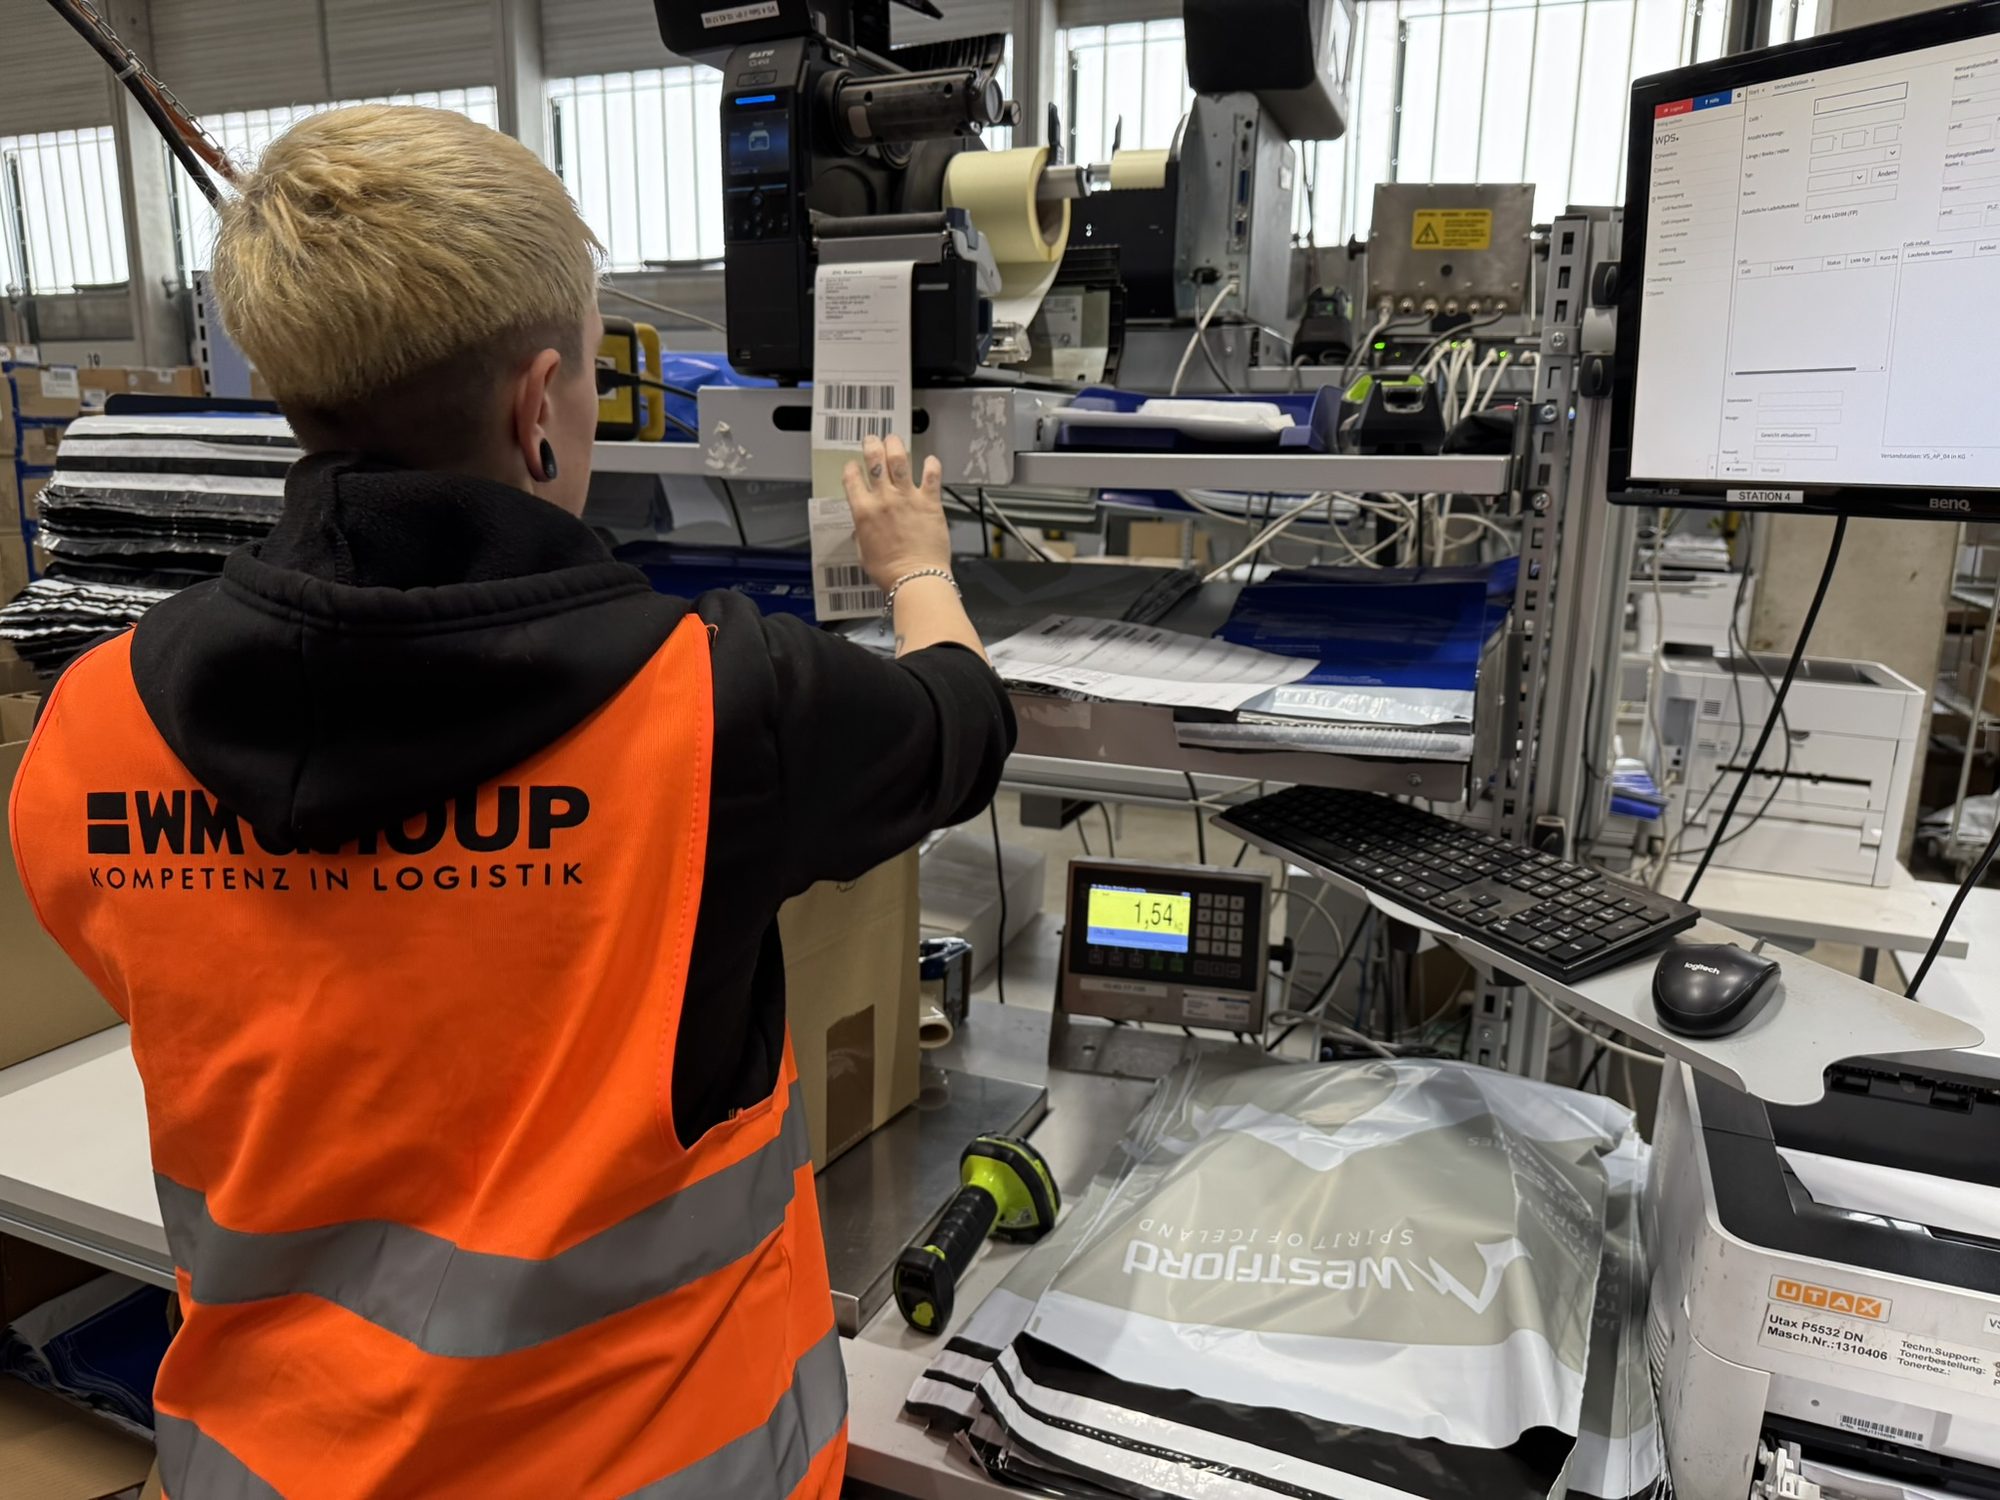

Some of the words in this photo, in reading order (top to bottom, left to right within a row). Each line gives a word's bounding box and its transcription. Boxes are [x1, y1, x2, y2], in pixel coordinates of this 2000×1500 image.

[1654, 133, 1680, 146] wps.
[1738, 491, 1782, 502] STATION
[1784, 492, 1791, 502] 4
[1929, 498, 1972, 511] BenQ
[88, 866, 290, 892] KOMPETENZ
[310, 867, 350, 891] IN
[373, 862, 585, 892] LOGISTIK
[1134, 900, 1173, 930] 1,54
[1684, 961, 1720, 976] logitech
[1138, 1218, 1259, 1244] ICELAND
[1267, 1233, 1303, 1248] OF
[1311, 1228, 1414, 1251] SPIRIT
[1778, 1281, 1881, 1317] UTAX
[1769, 1314, 1798, 1329] Utax
[1801, 1321, 1842, 1338] P5532
[1843, 1331, 1865, 1344] DN
[1767, 1325, 1889, 1361] Masch.Nr.:1310406
[1900, 1340, 1981, 1365] Techn.Support:
[1896, 1357, 1952, 1377] Tonerbez.:
[1899, 1348, 1987, 1376] Tonerbestellung:
